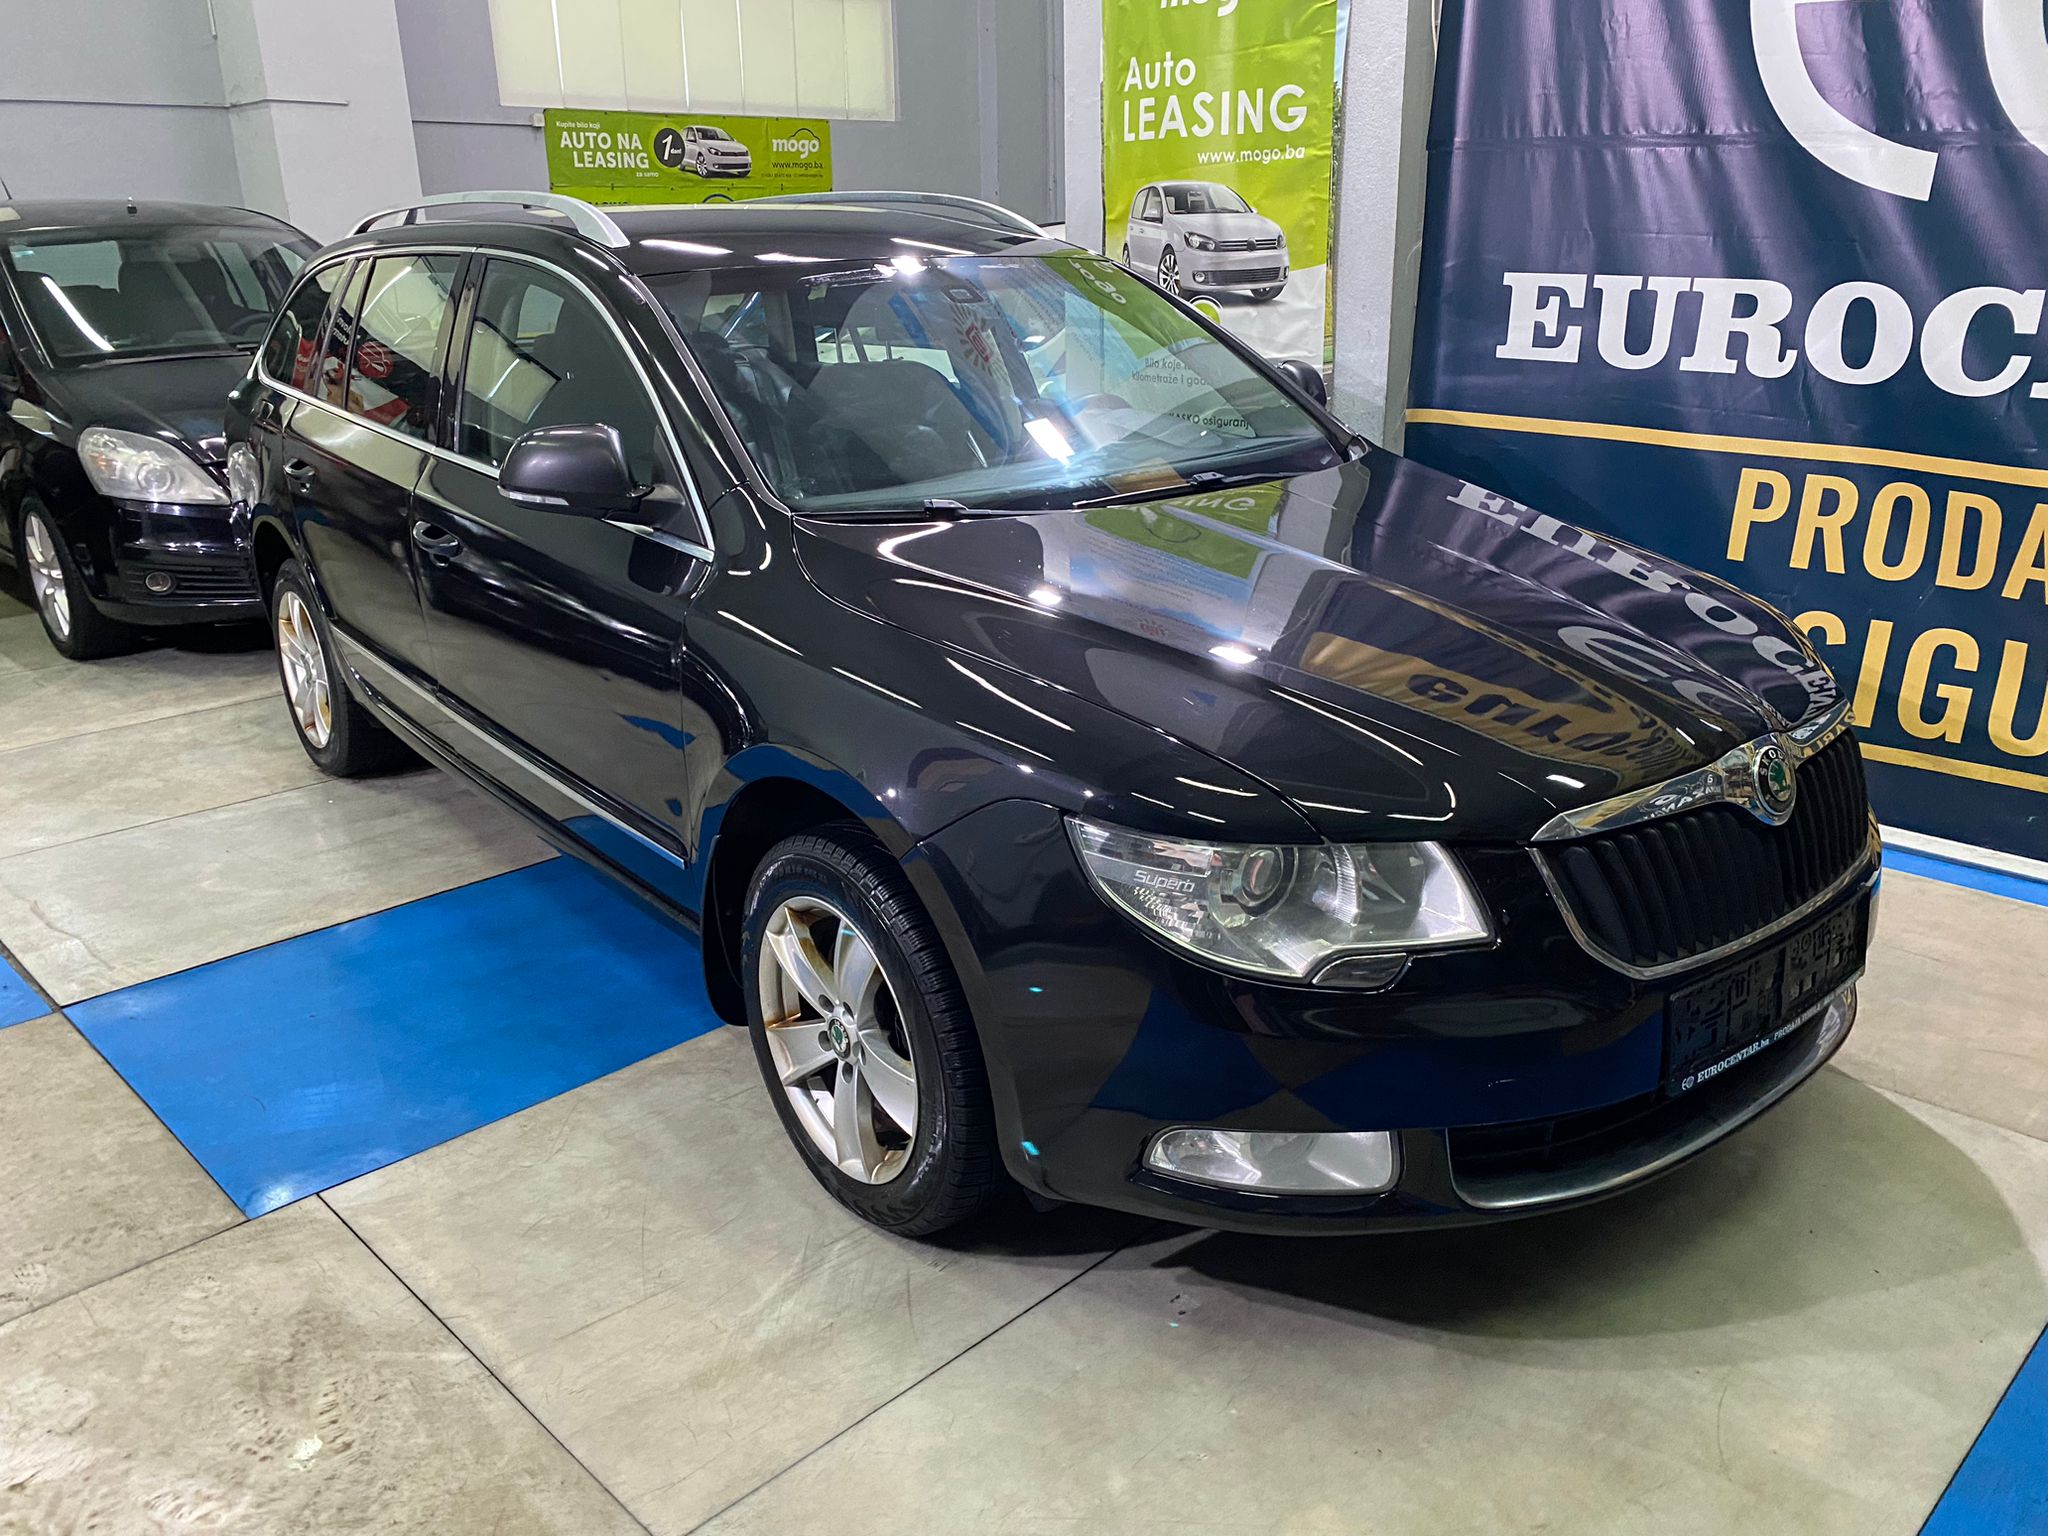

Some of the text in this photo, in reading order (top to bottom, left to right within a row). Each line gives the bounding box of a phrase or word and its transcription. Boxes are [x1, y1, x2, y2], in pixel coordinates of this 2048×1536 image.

[1124, 51, 1197, 92] Auto
[1123, 83, 1308, 143] LEASING
[560, 131, 643, 151] AUTO NA
[771, 138, 820, 159] mogo
[573, 151, 650, 169] LEASING
[1196, 144, 1307, 165] www.mogo.ba
[771, 161, 824, 171] www.mogo.ba
[1495, 271, 2048, 400] EUROC
[1133, 870, 1196, 892] Superb
[1696, 1038, 1770, 1083] EUROCENTAR.ba
